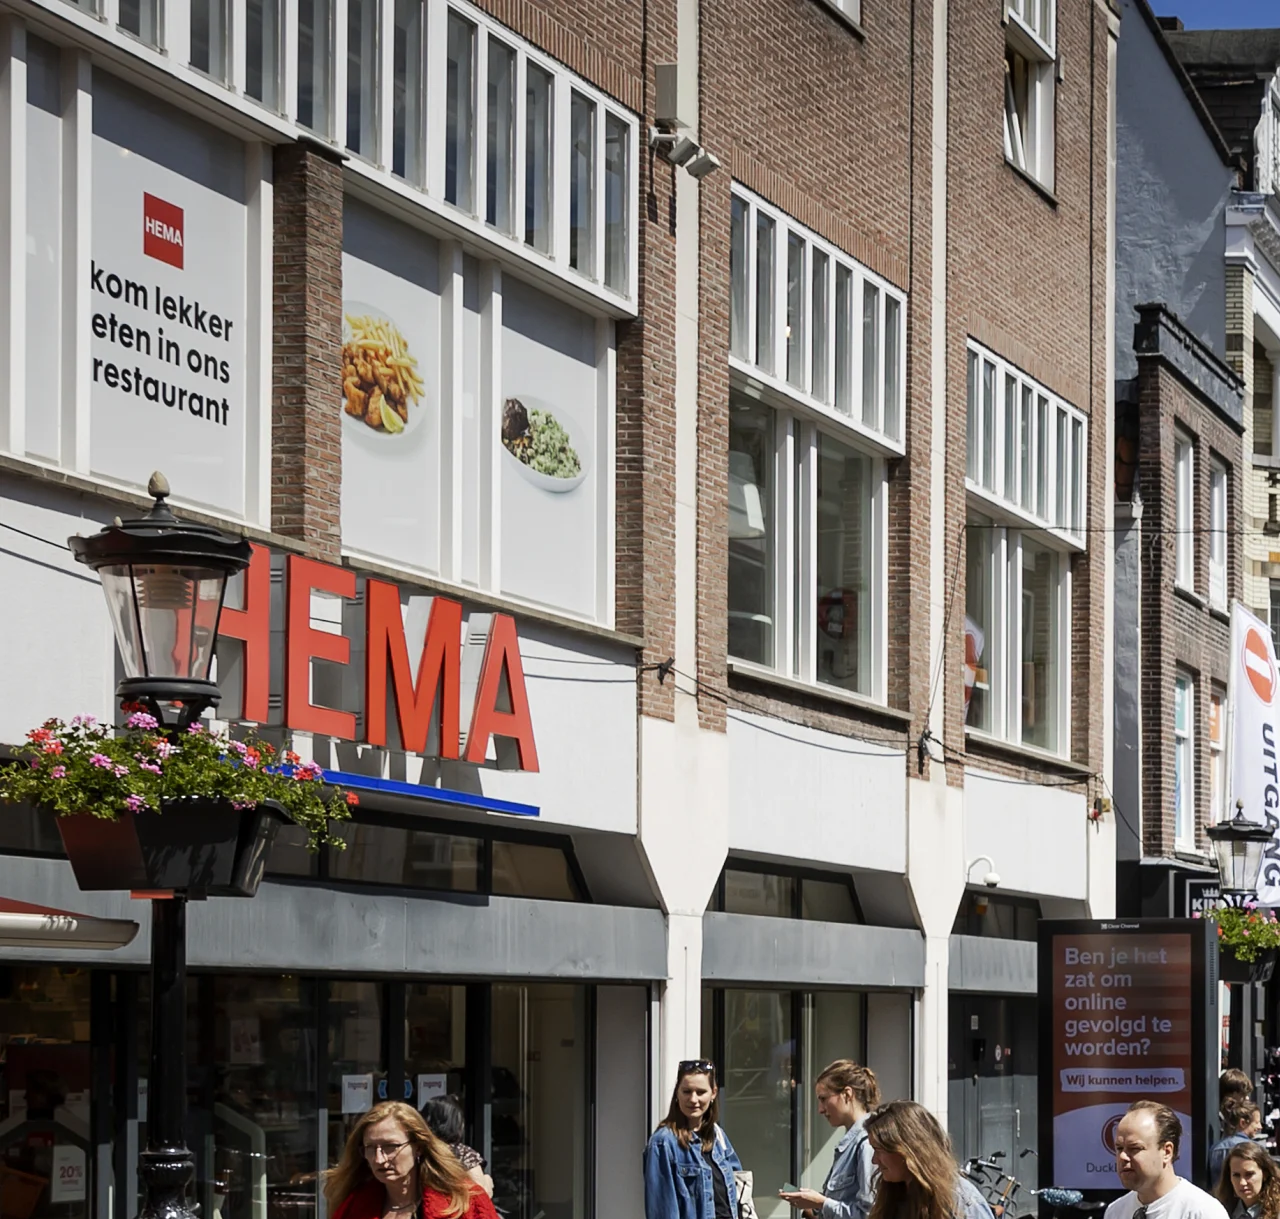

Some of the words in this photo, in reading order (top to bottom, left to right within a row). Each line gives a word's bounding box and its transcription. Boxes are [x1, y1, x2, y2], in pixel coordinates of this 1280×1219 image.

[145, 216, 183, 247] HEMA
[91, 260, 148, 311] kom
[155, 286, 233, 342] lekker
[92, 313, 151, 356] eten
[158, 327, 180, 366] in
[187, 349, 230, 384] ons
[93, 357, 229, 426] restaurant
[178, 542, 540, 774] HEMA
[1065, 948, 1104, 965] Ben
[1108, 947, 1128, 968] je
[1134, 948, 1167, 965] het
[1065, 972, 1095, 988] zat
[1101, 974, 1132, 988] om
[1065, 993, 1127, 1010] online
[1065, 1016, 1146, 1037] gevolgd
[1152, 1017, 1172, 1032] te
[1065, 1038, 1151, 1056] worden?
[1066, 1075, 1085, 1087] Wij
[1088, 1075, 1133, 1085] kunnen
[1136, 1075, 1179, 1087] helpen.
[1087, 1162, 1117, 1173] Duck
